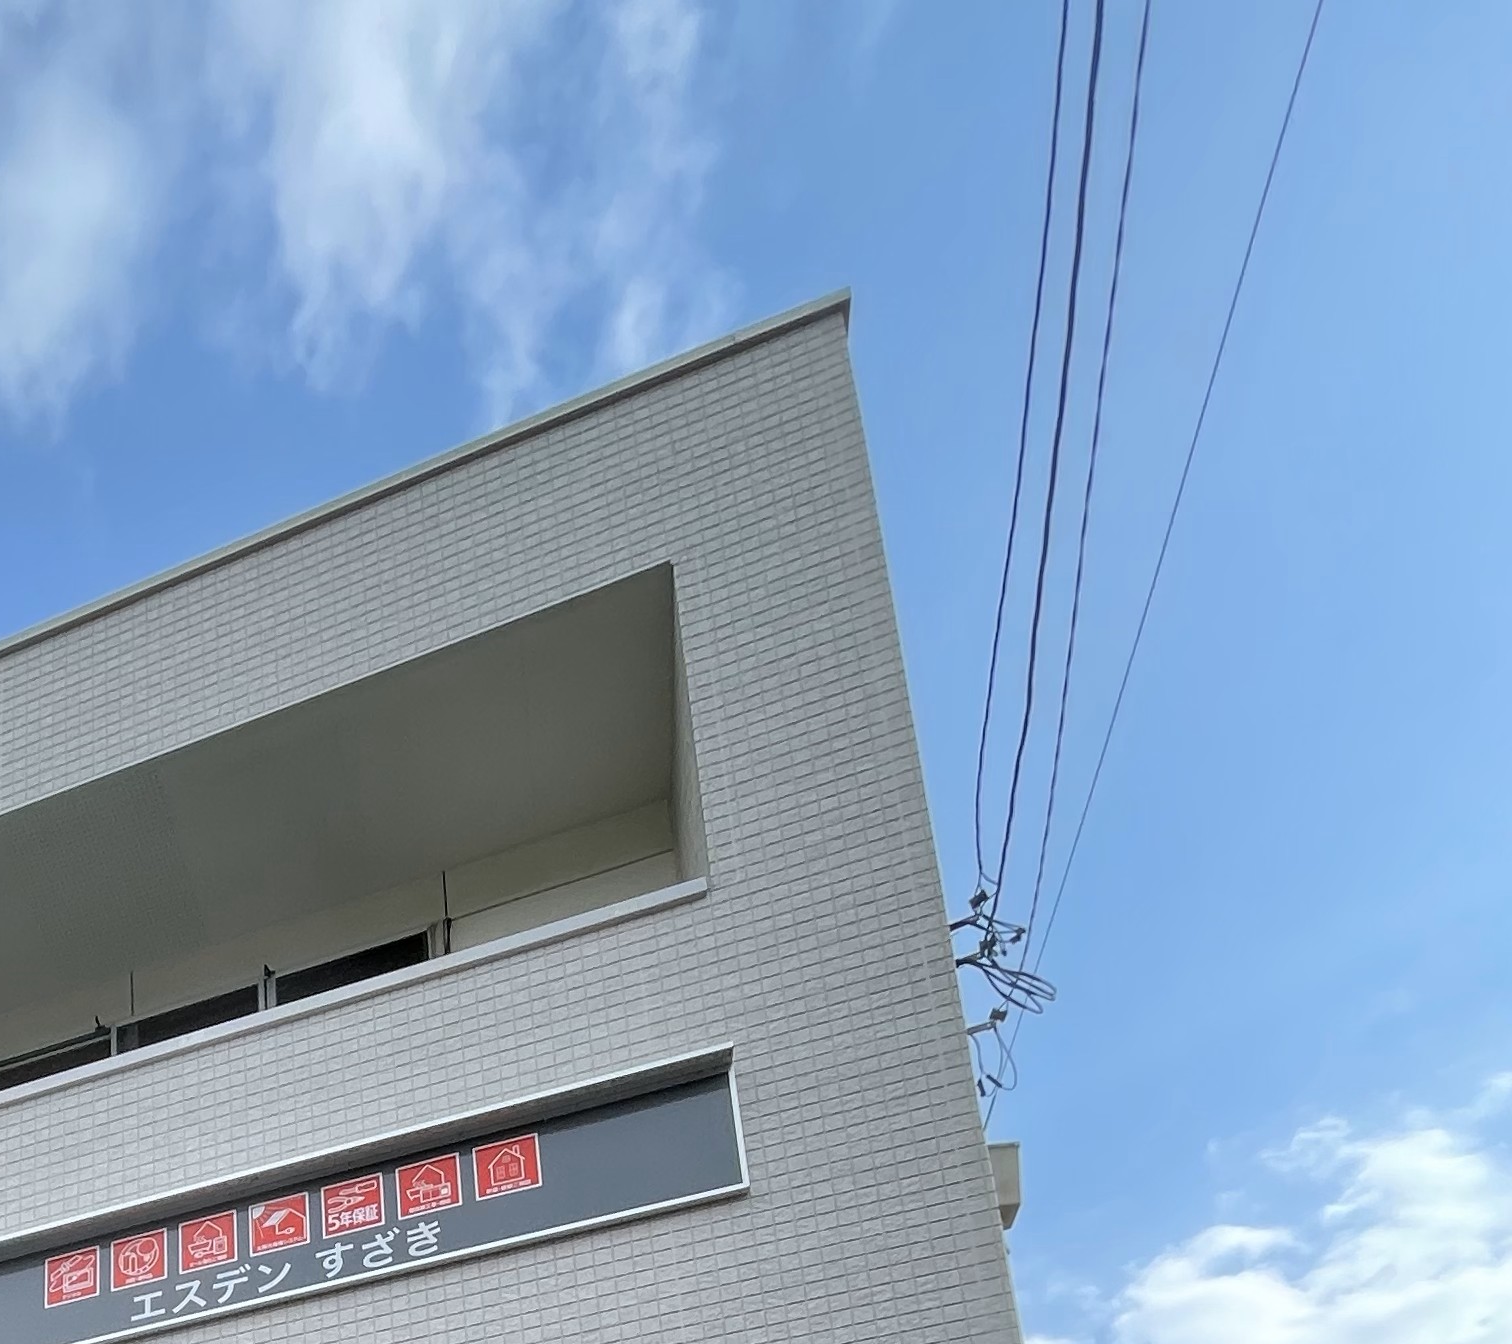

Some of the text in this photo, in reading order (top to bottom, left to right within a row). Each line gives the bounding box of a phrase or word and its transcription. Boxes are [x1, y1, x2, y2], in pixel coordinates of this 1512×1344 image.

[327, 1203, 379, 1233] 5年保証
[130, 1220, 443, 1322] エスデン すざき
